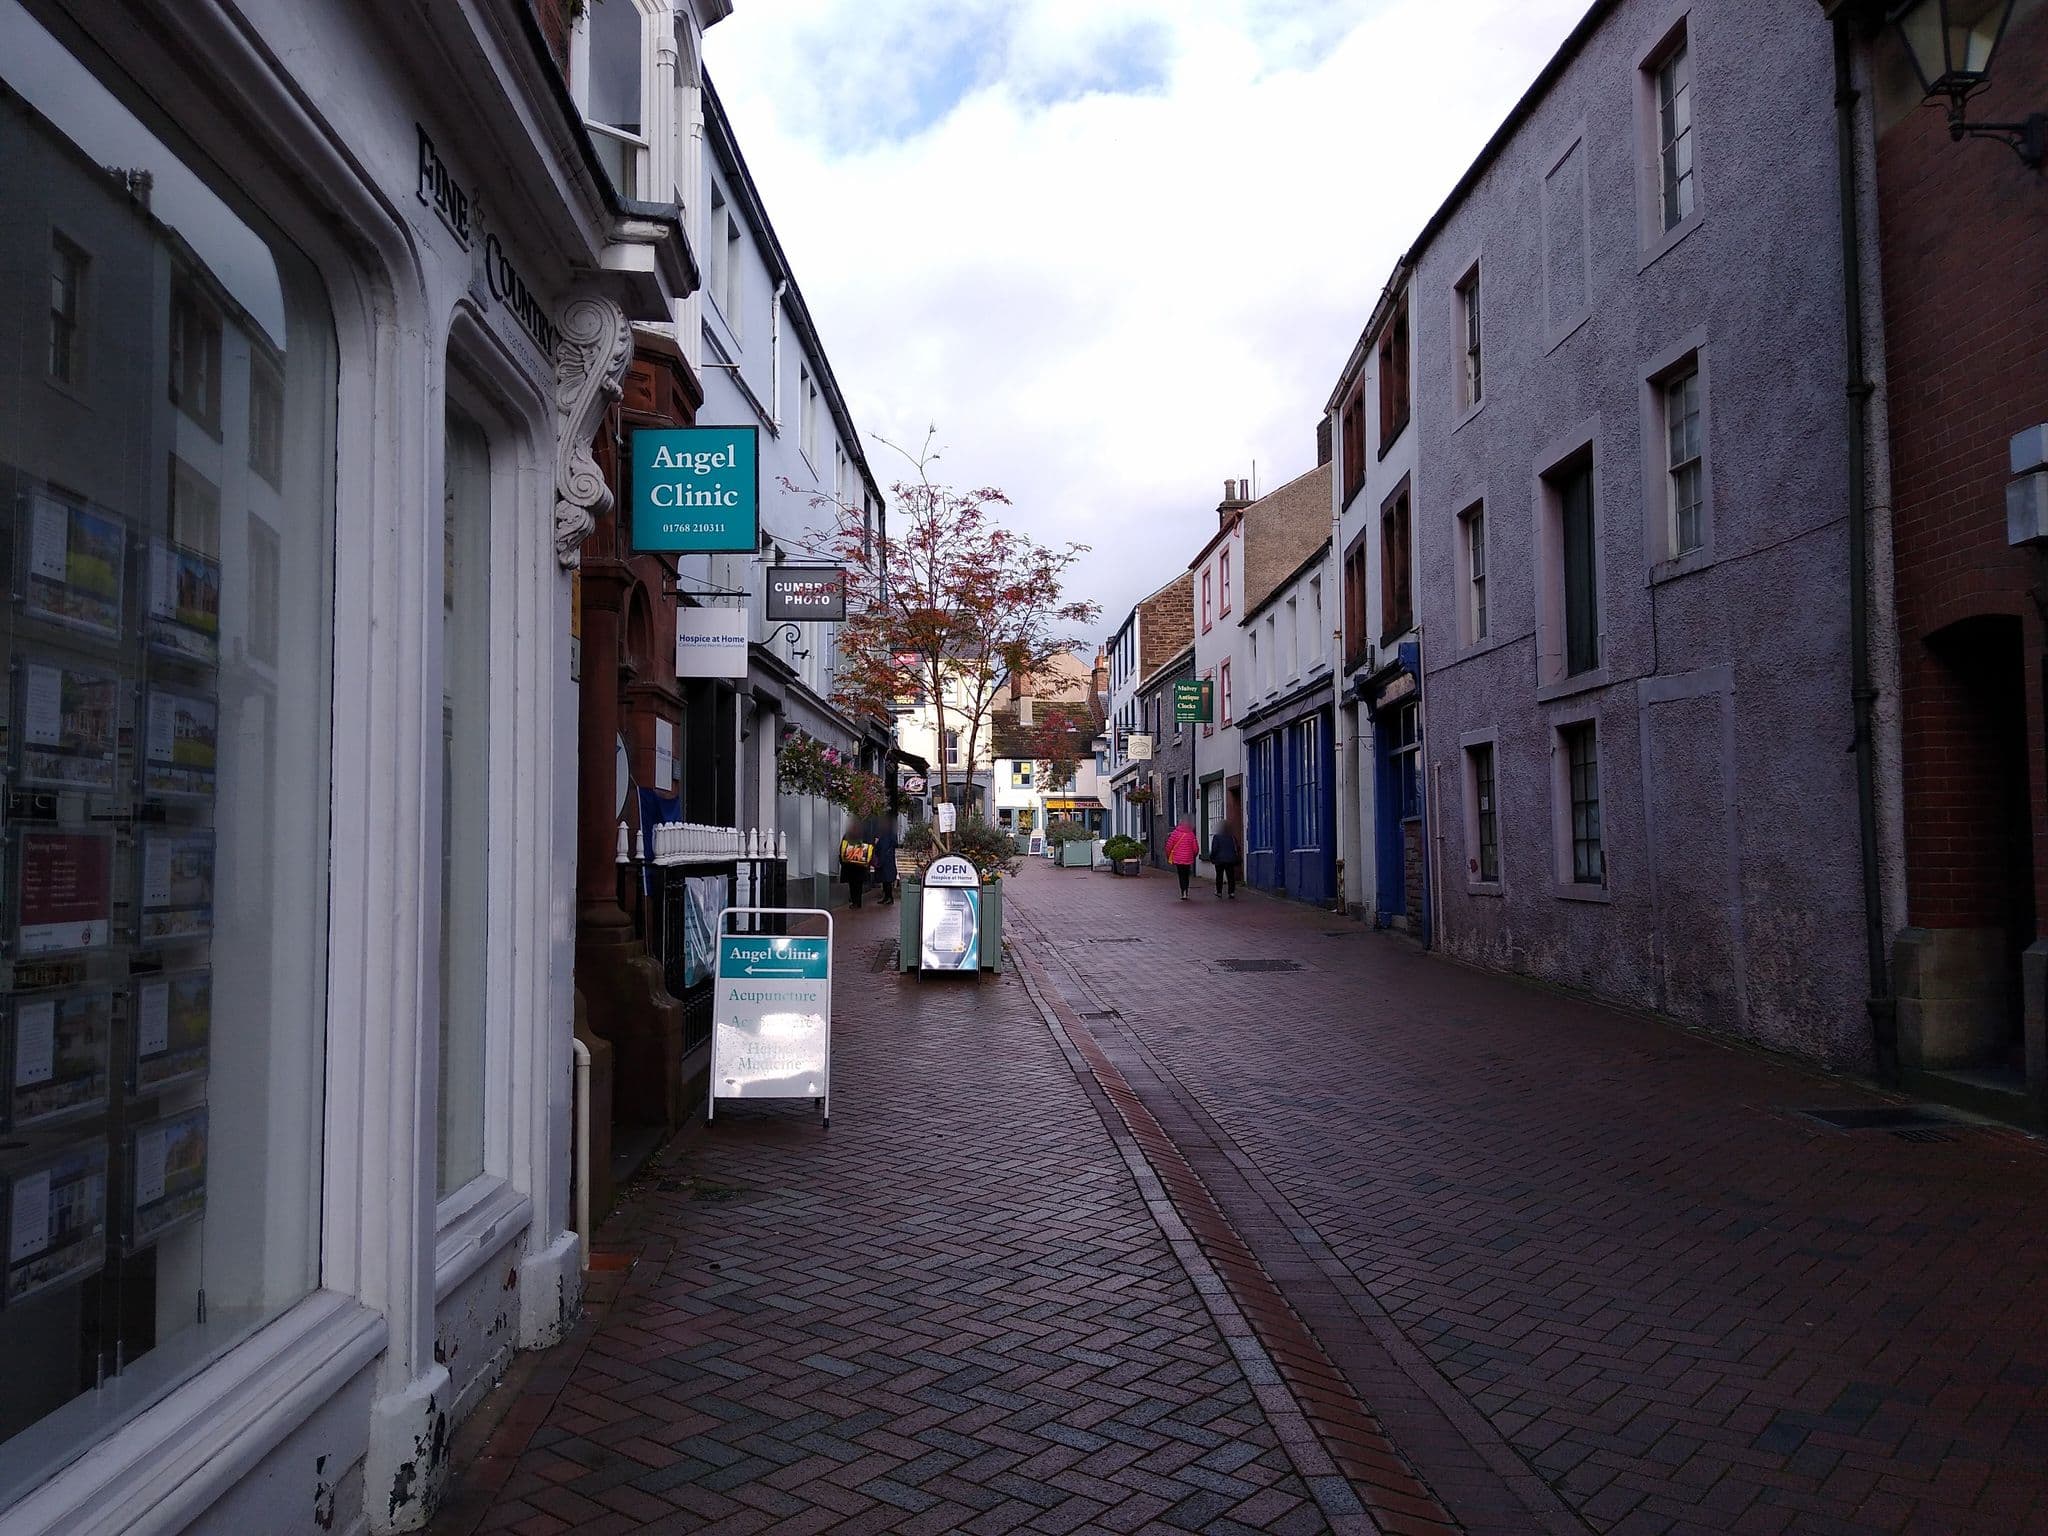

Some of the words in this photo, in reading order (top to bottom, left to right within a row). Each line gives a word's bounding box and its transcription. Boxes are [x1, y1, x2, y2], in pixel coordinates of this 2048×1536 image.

[651, 444, 736, 474] Angel
[650, 483, 738, 506] Clinic
[663, 523, 690, 532] 01768
[692, 523, 725, 532] 210311
[774, 582, 837, 592] CUMBR
[785, 595, 830, 605] PHOTO
[679, 634, 711, 644] Hospice
[712, 635, 720, 643] at
[721, 635, 745, 643] Home
[936, 864, 967, 874] OPEN
[729, 947, 772, 962] Angel
[775, 947, 820, 960] Clinic
[728, 988, 817, 1004] Acupuncture
